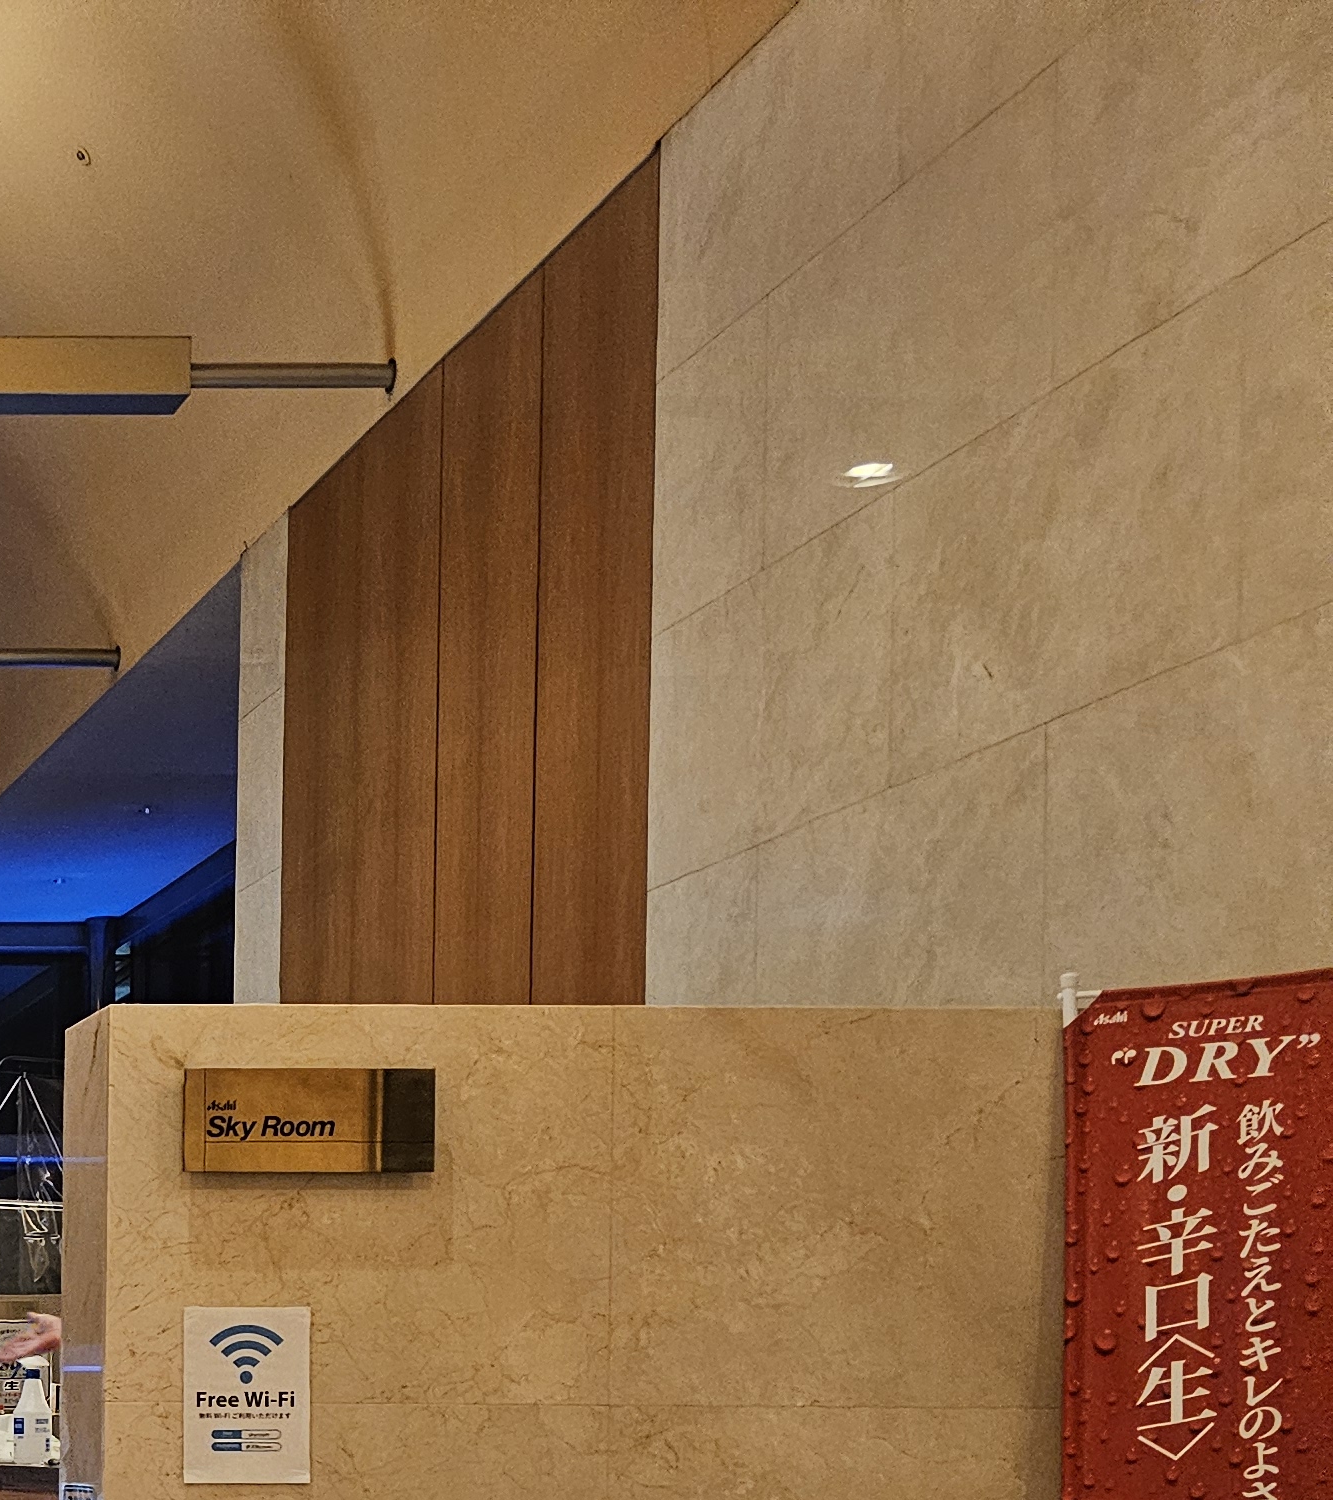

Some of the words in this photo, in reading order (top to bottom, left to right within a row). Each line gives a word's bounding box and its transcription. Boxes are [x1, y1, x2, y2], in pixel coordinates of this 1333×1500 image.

[1093, 1011, 1128, 1026] Asahi
[1168, 1014, 1266, 1039] SUPER
[206, 1099, 237, 1112] Asahi
[206, 1115, 257, 1141] Sky
[261, 1116, 336, 1138] Room
[4, 1380, 20, 1391] 生
[196, 1391, 240, 1408] Free
[244, 1391, 295, 1408] Wi-Fi
[232, 1412, 291, 1420] ご利用いただけます
